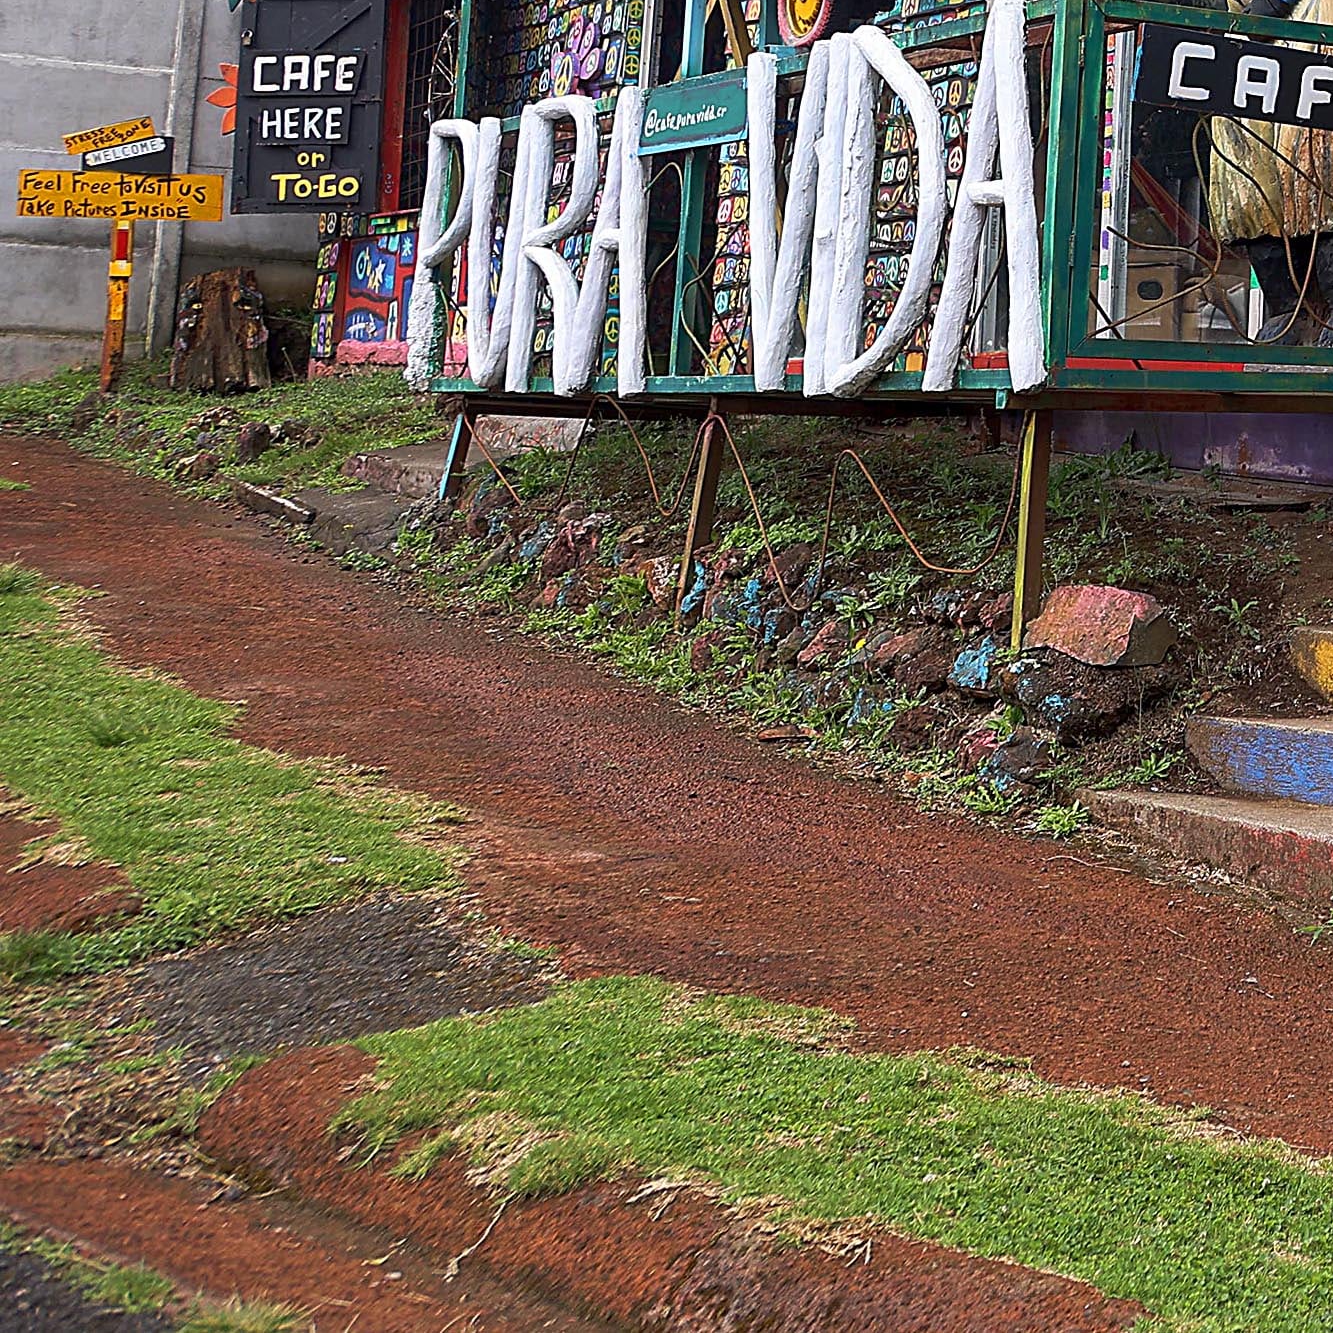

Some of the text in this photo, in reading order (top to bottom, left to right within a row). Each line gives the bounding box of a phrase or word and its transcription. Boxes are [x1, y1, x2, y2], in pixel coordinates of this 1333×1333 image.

[253, 54, 358, 92] CAFE
[262, 107, 343, 140] HERE
[64, 128, 105, 148] STRESS
[92, 140, 159, 163] WELCOME
[297, 152, 325, 168] or
[23, 171, 61, 191] Feel
[72, 172, 111, 194] Free
[18, 195, 55, 216] Take
[405, 86, 647, 398] PURA
